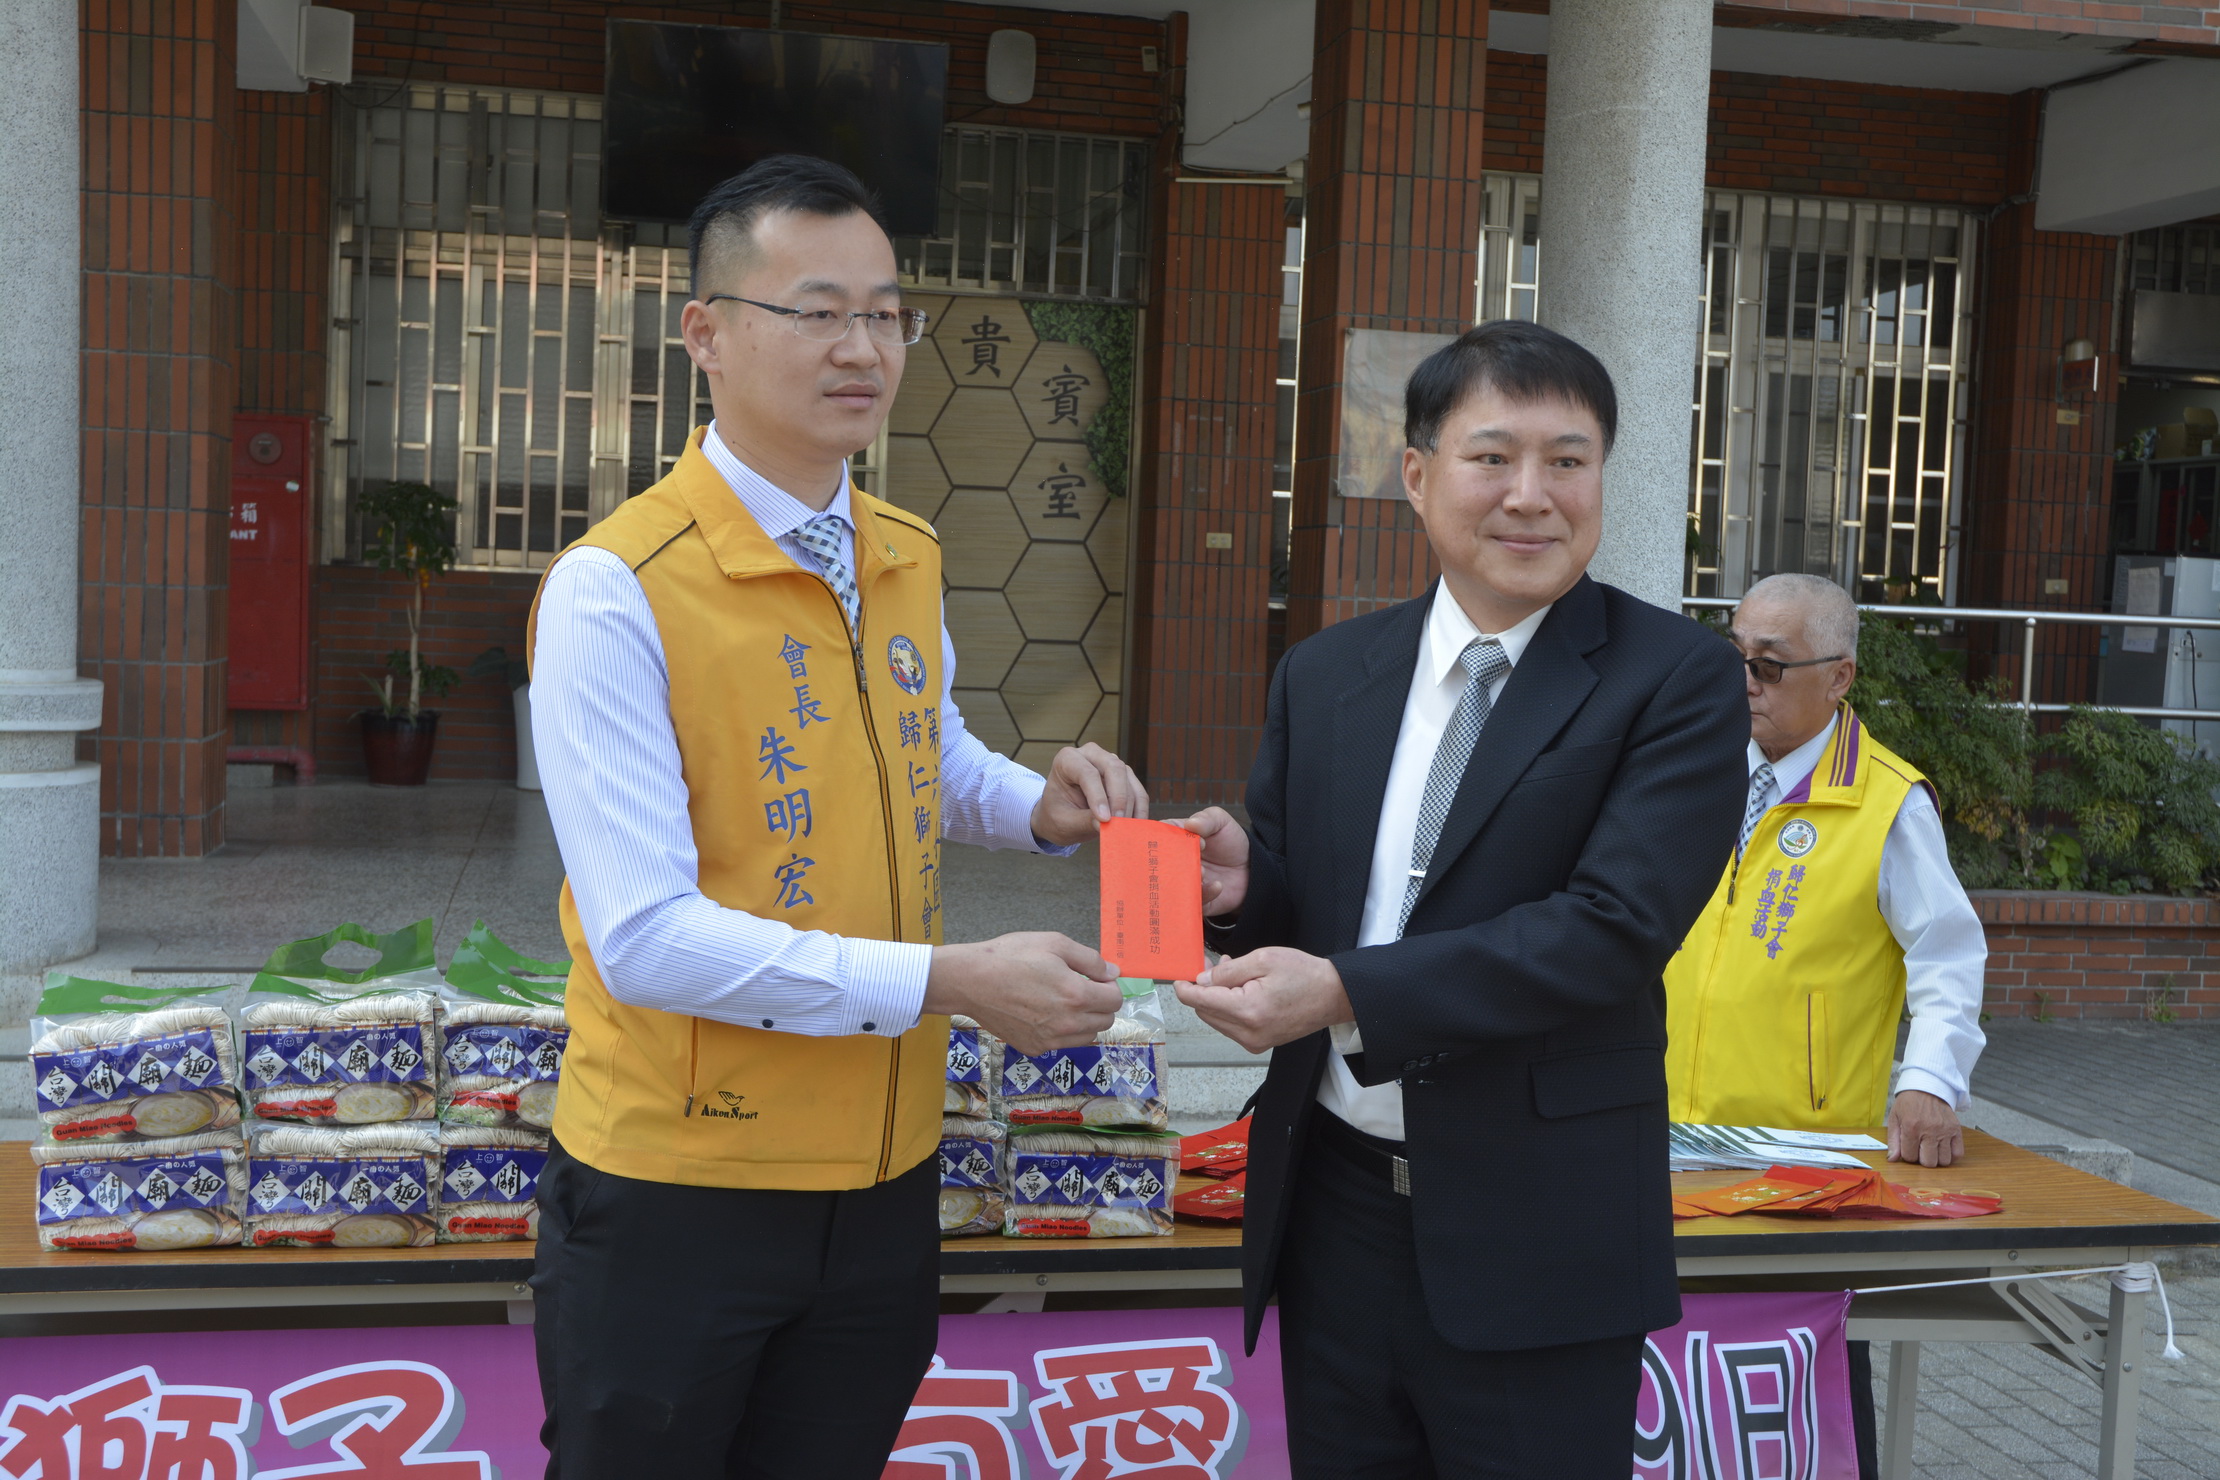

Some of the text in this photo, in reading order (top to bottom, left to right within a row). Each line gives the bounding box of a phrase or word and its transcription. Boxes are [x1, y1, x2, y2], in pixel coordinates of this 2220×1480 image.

[961, 315, 1091, 520] 貴賓室
[758, 633, 832, 909] 會長 朱明宏
[898, 711, 935, 941] 歸仁獅子會
[1750, 867, 1783, 939] 捐血活動
[1765, 863, 1807, 960] 歸仁獅子會
[56, 1126, 78, 1136] Guan
[79, 1124, 99, 1132] Miao
[77, 1238, 97, 1246] Miao
[452, 1221, 526, 1229] Guan Miao Noodles
